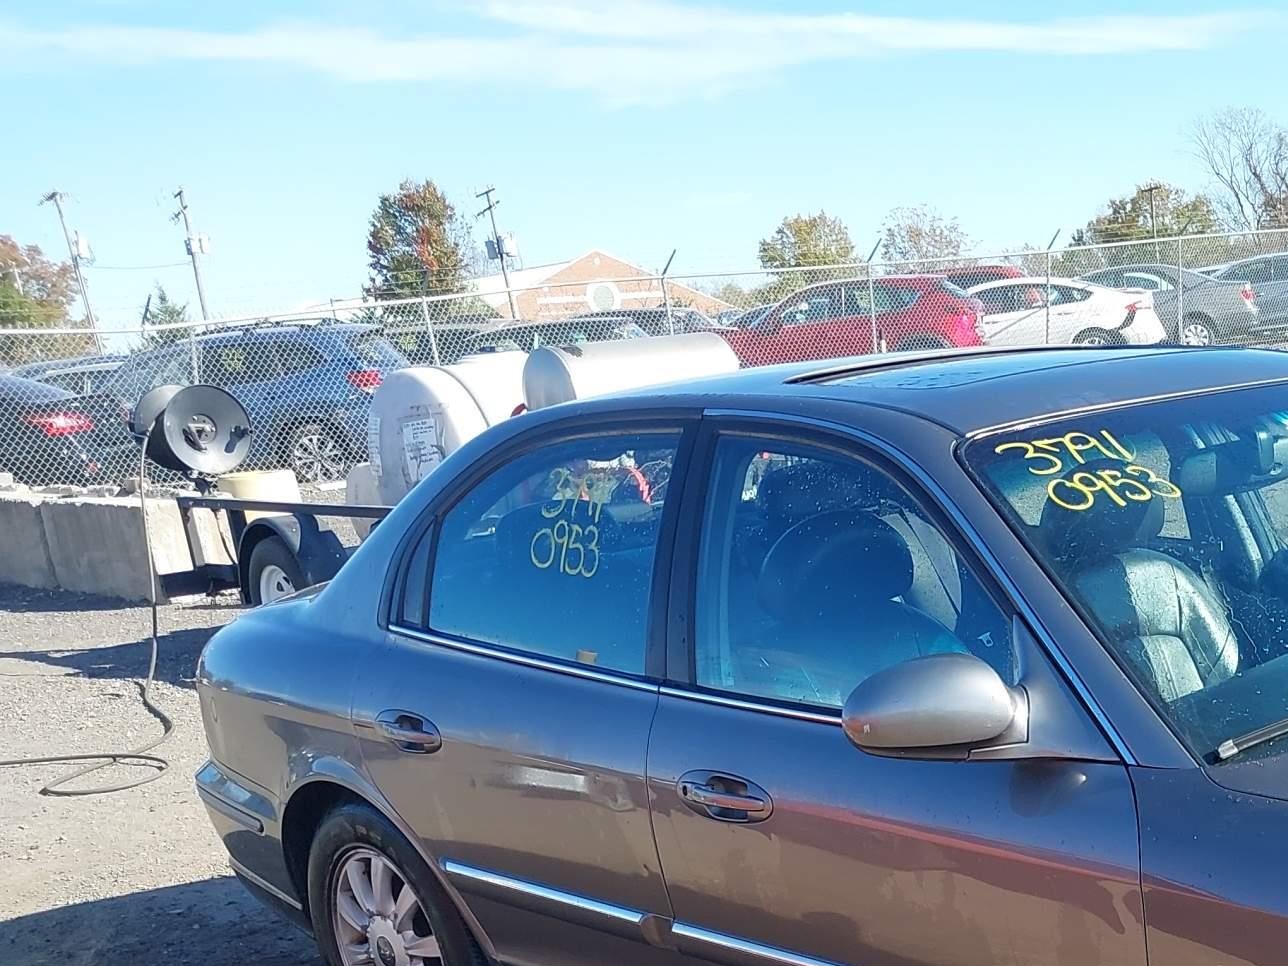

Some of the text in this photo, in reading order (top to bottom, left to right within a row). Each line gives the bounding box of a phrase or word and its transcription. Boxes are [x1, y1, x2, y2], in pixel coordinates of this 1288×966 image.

[994, 429, 1135, 475] 3791
[1047, 465, 1182, 510] 0953
[530, 519, 600, 577] 0953
